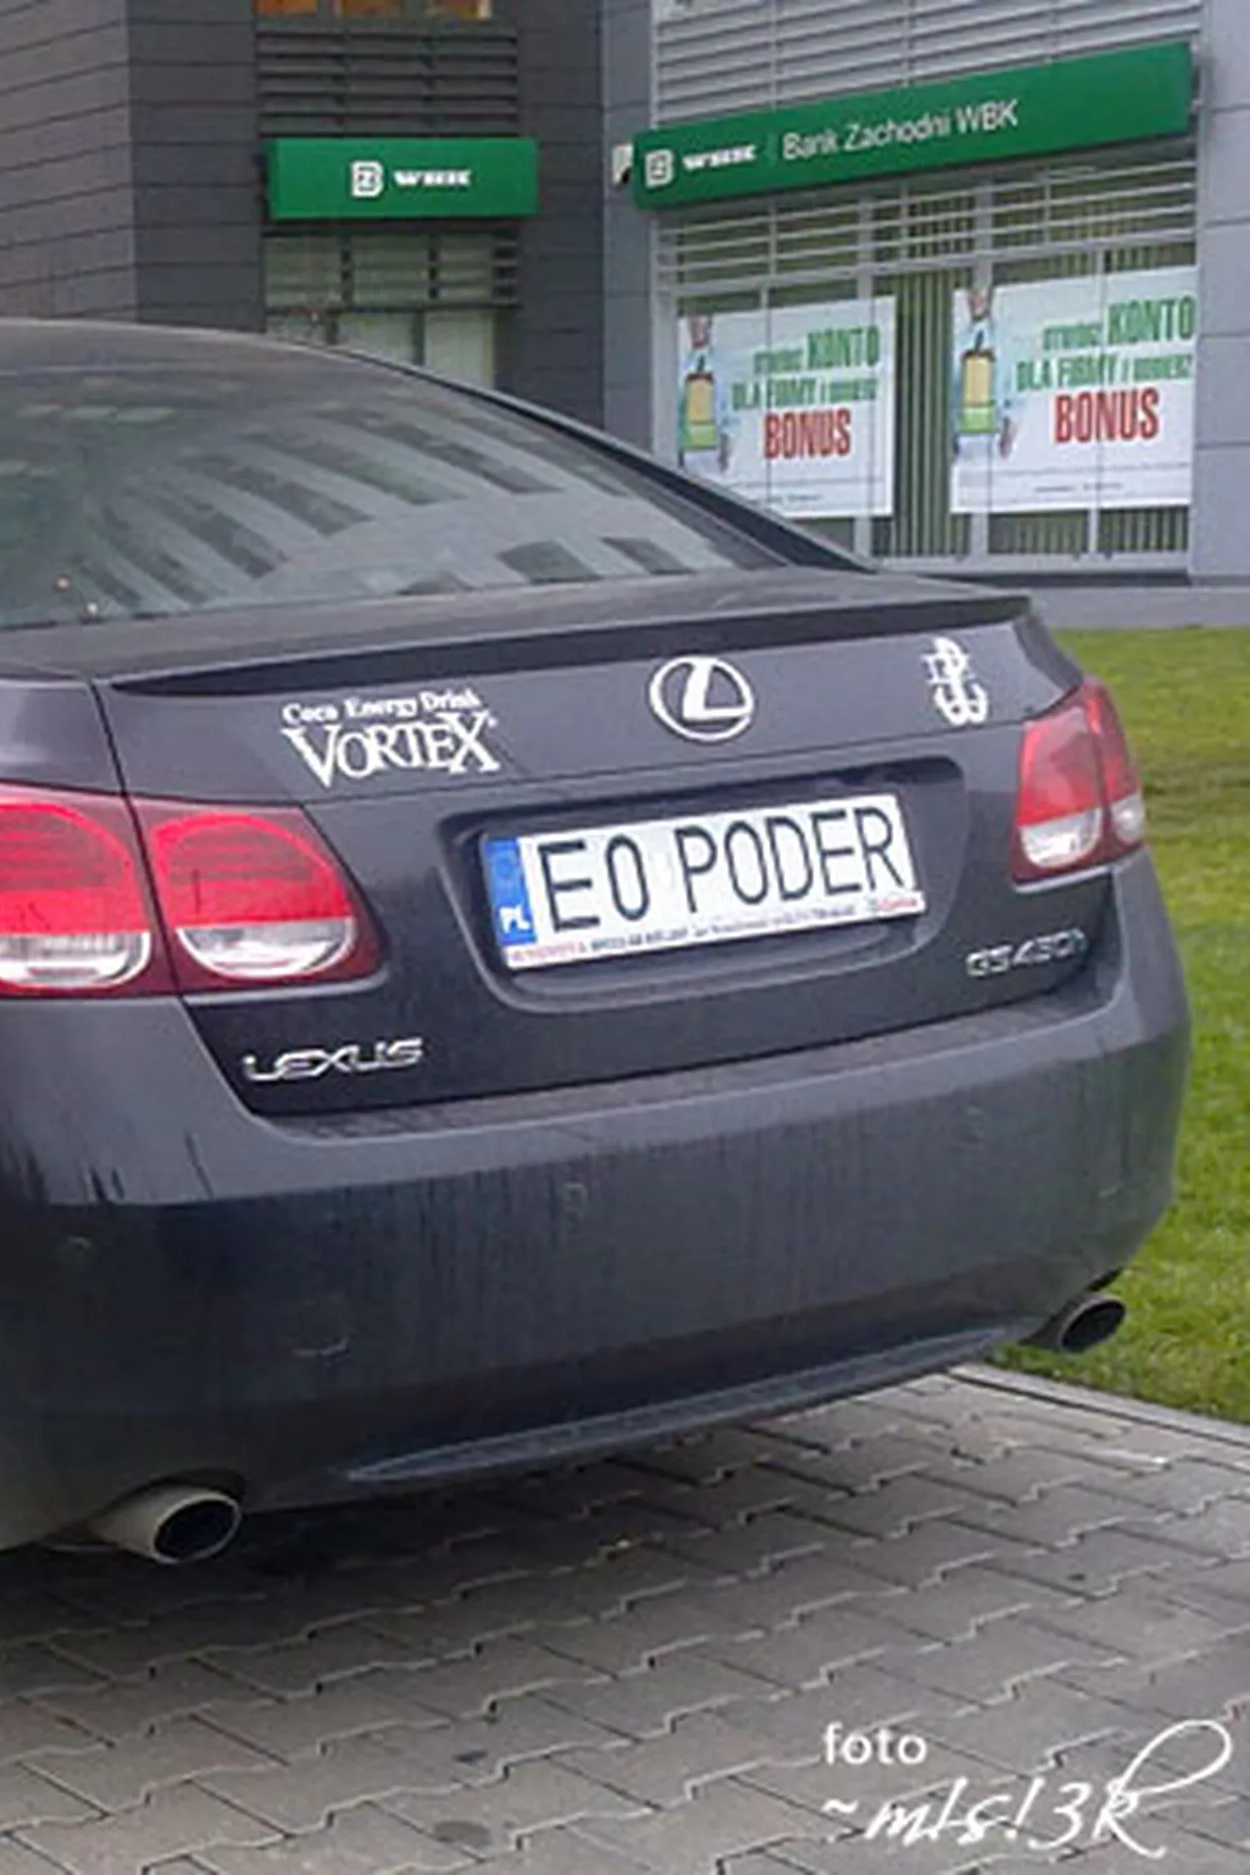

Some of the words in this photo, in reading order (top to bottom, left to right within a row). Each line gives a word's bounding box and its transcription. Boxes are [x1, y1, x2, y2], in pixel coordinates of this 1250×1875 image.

[782, 128, 839, 160] Bank
[844, 108, 951, 150] Zachodni
[955, 98, 1019, 134] WBK
[1107, 296, 1196, 345] KONTO
[807, 326, 880, 370] KONTO
[764, 407, 851, 459] BONUS
[1055, 388, 1159, 443] BONUS
[418, 688, 483, 711] Drink
[499, 904, 531, 933] PL
[673, 806, 905, 914] PODER
[242, 1036, 423, 1082] LEXUS
